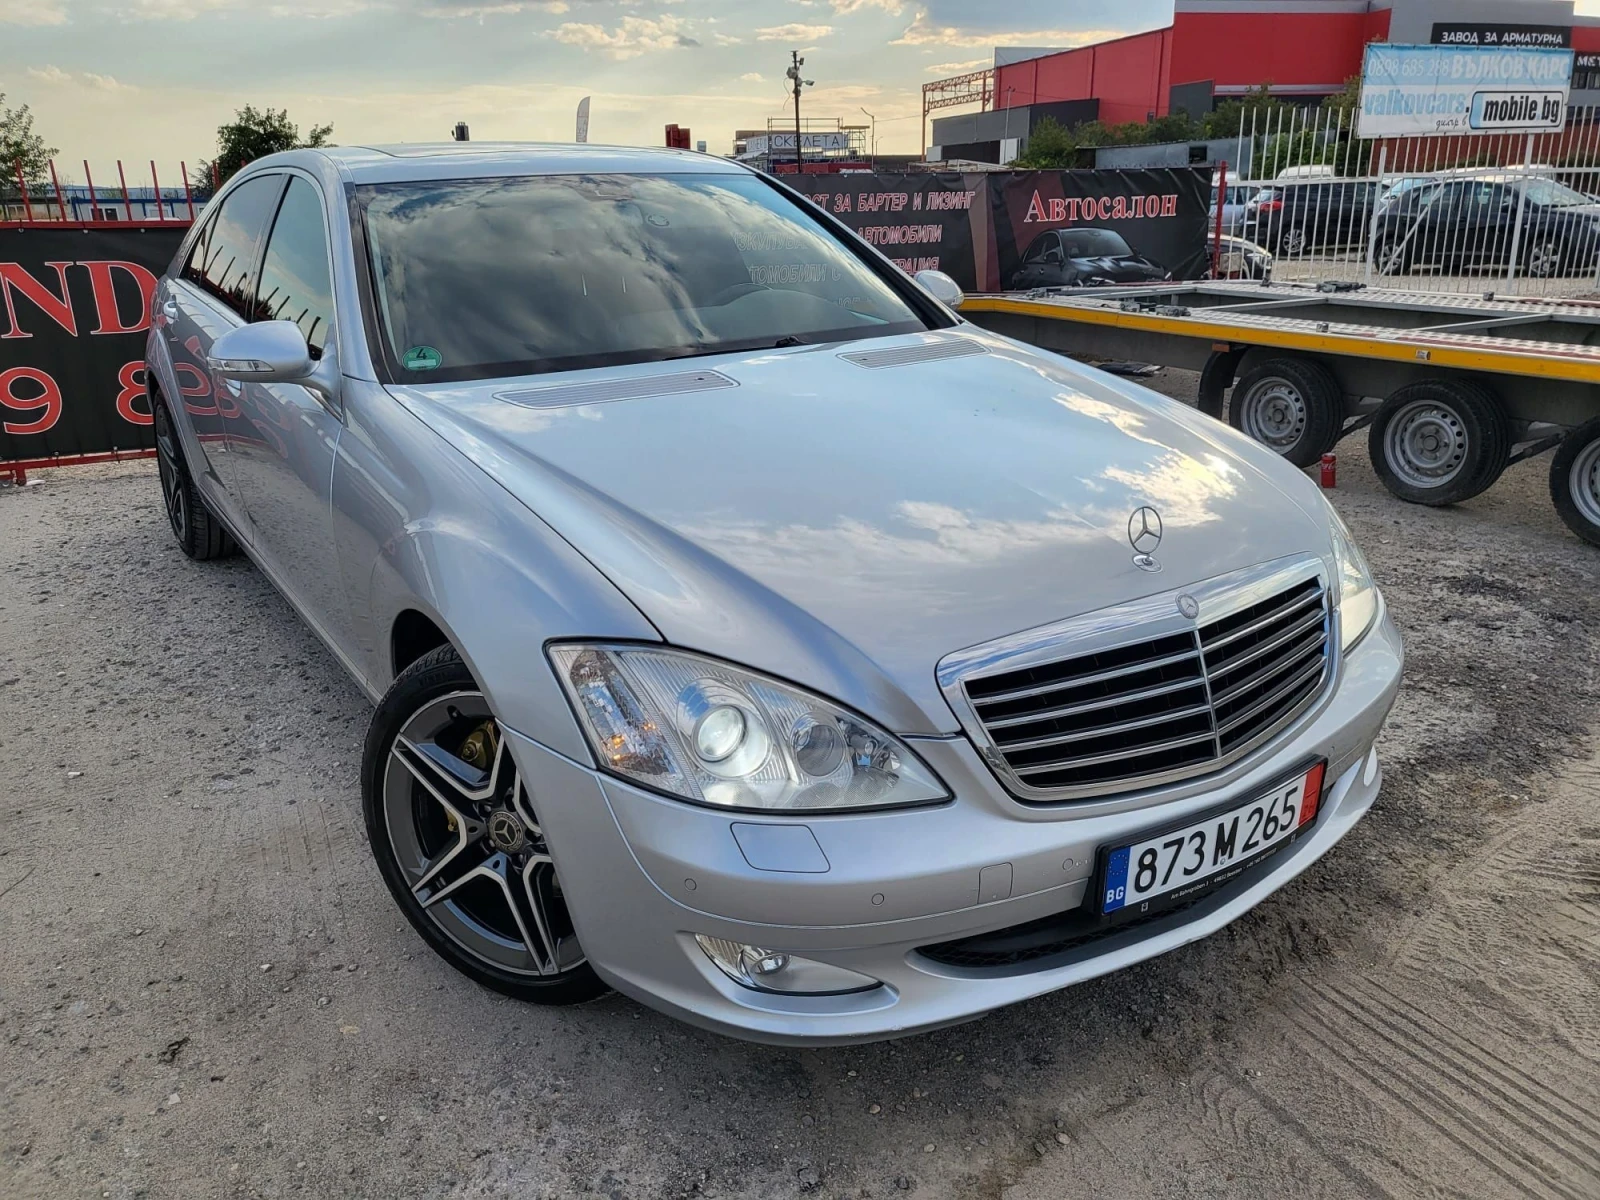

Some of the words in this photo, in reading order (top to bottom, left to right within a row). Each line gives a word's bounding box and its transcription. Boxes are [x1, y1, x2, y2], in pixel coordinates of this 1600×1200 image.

[1441, 32, 1478, 44] ЗАВОД
[1484, 32, 1498, 43] ЗА
[1502, 32, 1563, 45] АРМАТУРНА
[1367, 57, 1399, 76] 0898
[1402, 57, 1424, 76] 685
[1450, 55, 1523, 79] ВЪЛКОВ
[1526, 54, 1570, 80] КАРС
[834, 193, 852, 212] ЗА
[857, 192, 909, 212] БАРТЕР
[913, 192, 922, 211] И
[926, 191, 976, 210] ЛИЗИНГ
[1023, 189, 1178, 224] Автосалон
[416, 348, 428, 359] 4
[1106, 886, 1124, 904] BG
